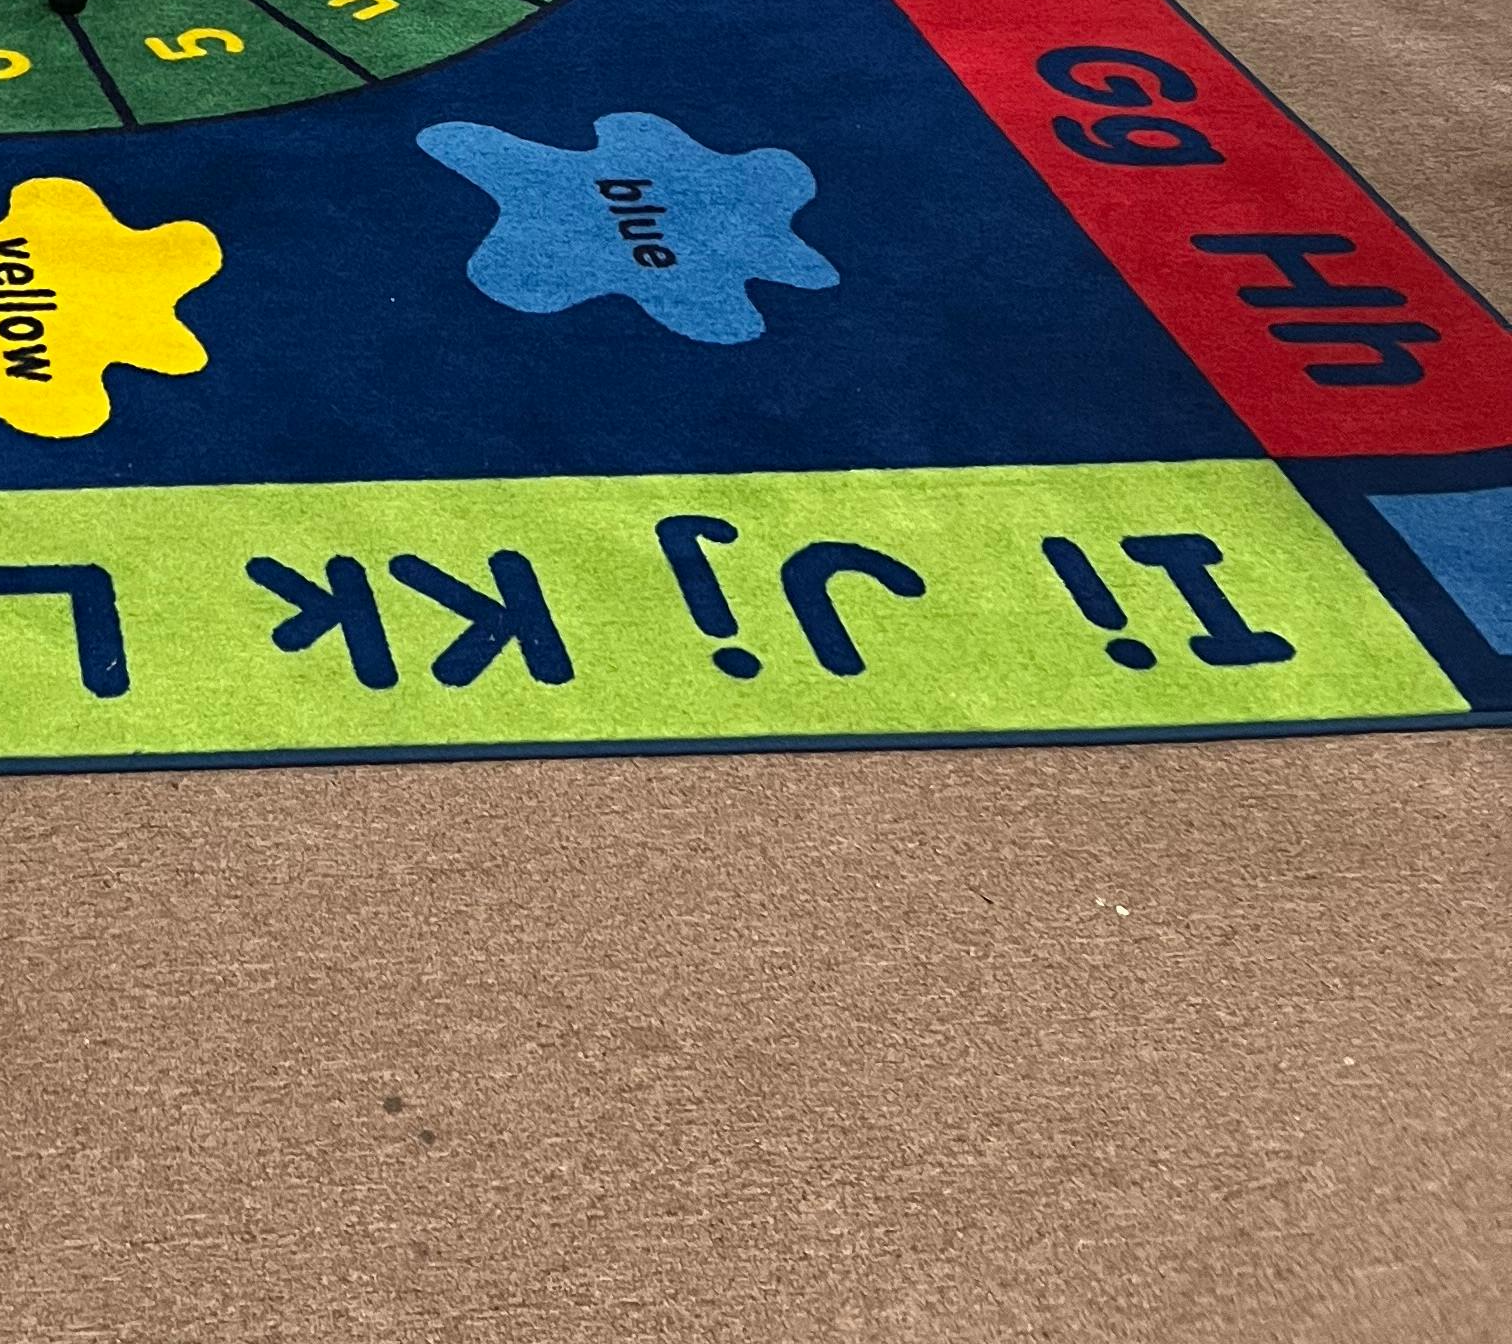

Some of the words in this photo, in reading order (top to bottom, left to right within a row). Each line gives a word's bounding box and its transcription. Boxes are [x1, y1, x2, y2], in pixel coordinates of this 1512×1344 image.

[144, 27, 245, 61] 5
[593, 177, 679, 269] blue
[1034, 44, 1227, 168] Gg
[1188, 233, 1443, 389] Hh
[245, 549, 576, 690] Kk
[655, 514, 928, 681] Jj
[1040, 533, 1297, 670] Ii
